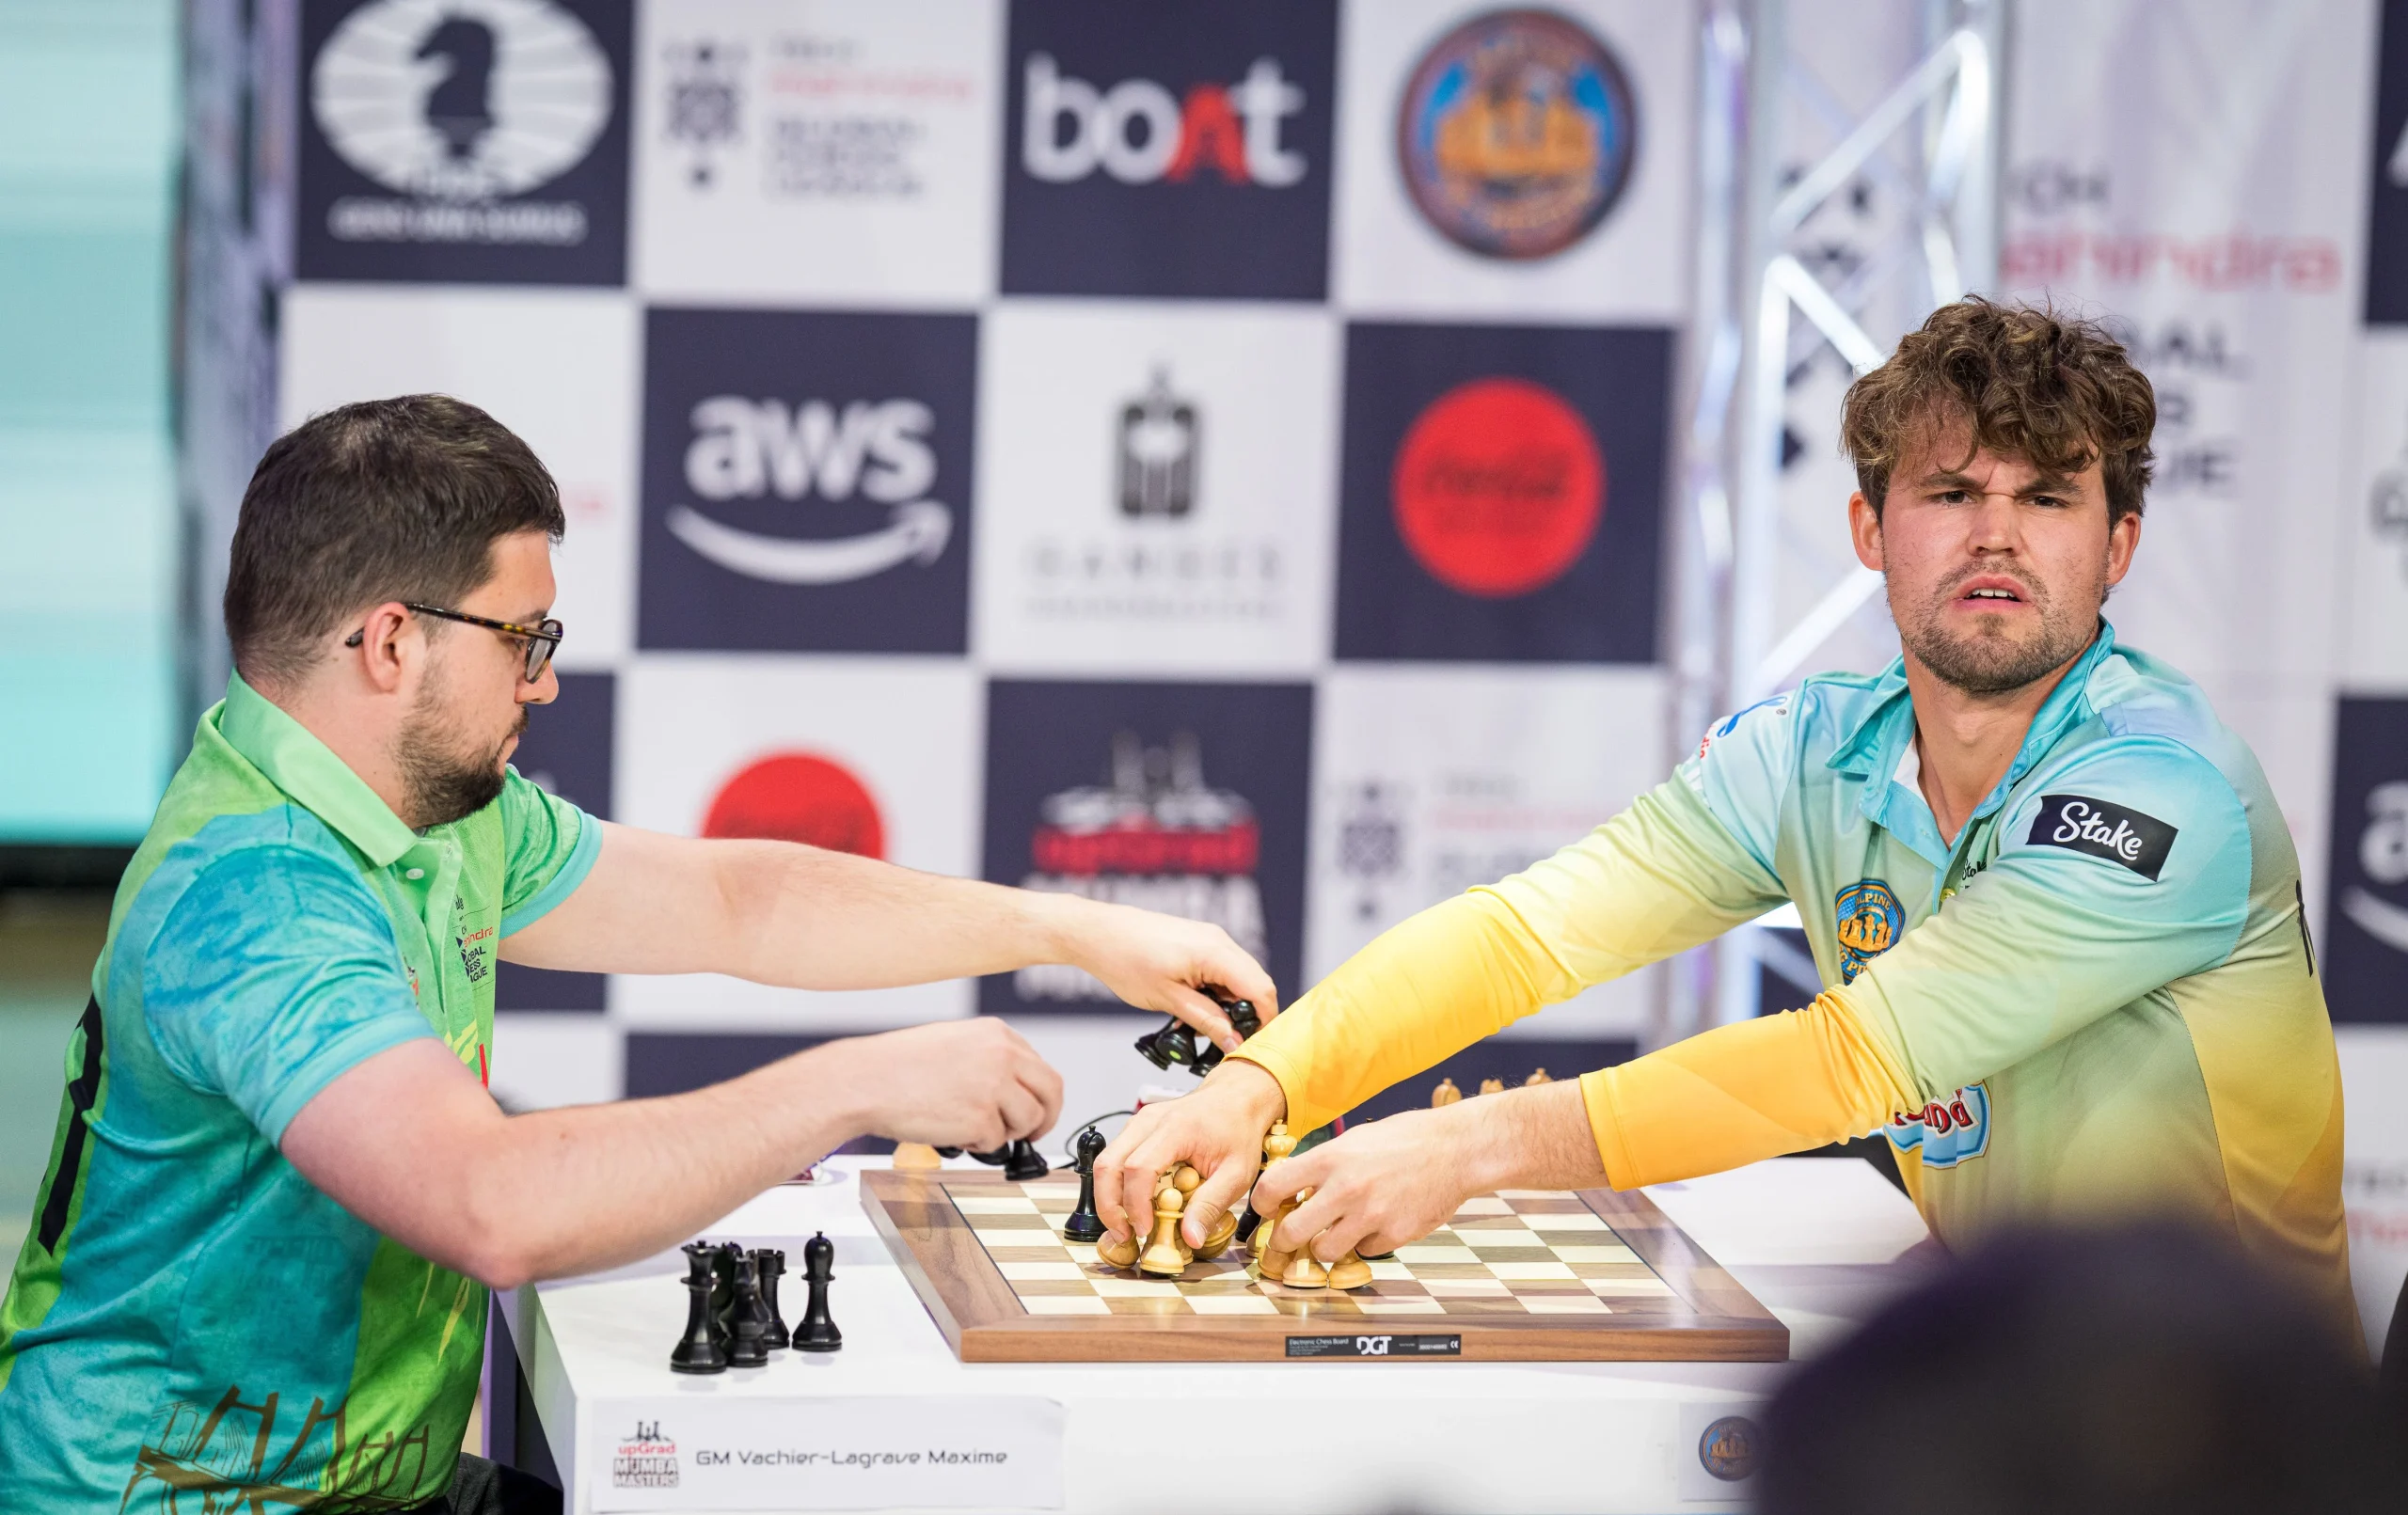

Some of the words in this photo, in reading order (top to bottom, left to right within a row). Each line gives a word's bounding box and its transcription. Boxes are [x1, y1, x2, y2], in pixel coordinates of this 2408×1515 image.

[685, 394, 938, 502] aws
[2052, 801, 2143, 861] Stake
[1356, 1335, 1393, 1355] DGT
[618, 1441, 676, 1456] upGrad
[695, 1449, 731, 1466] GM
[737, 1449, 921, 1469] Vachier-Lagrave
[927, 1449, 1008, 1465] Maxime
